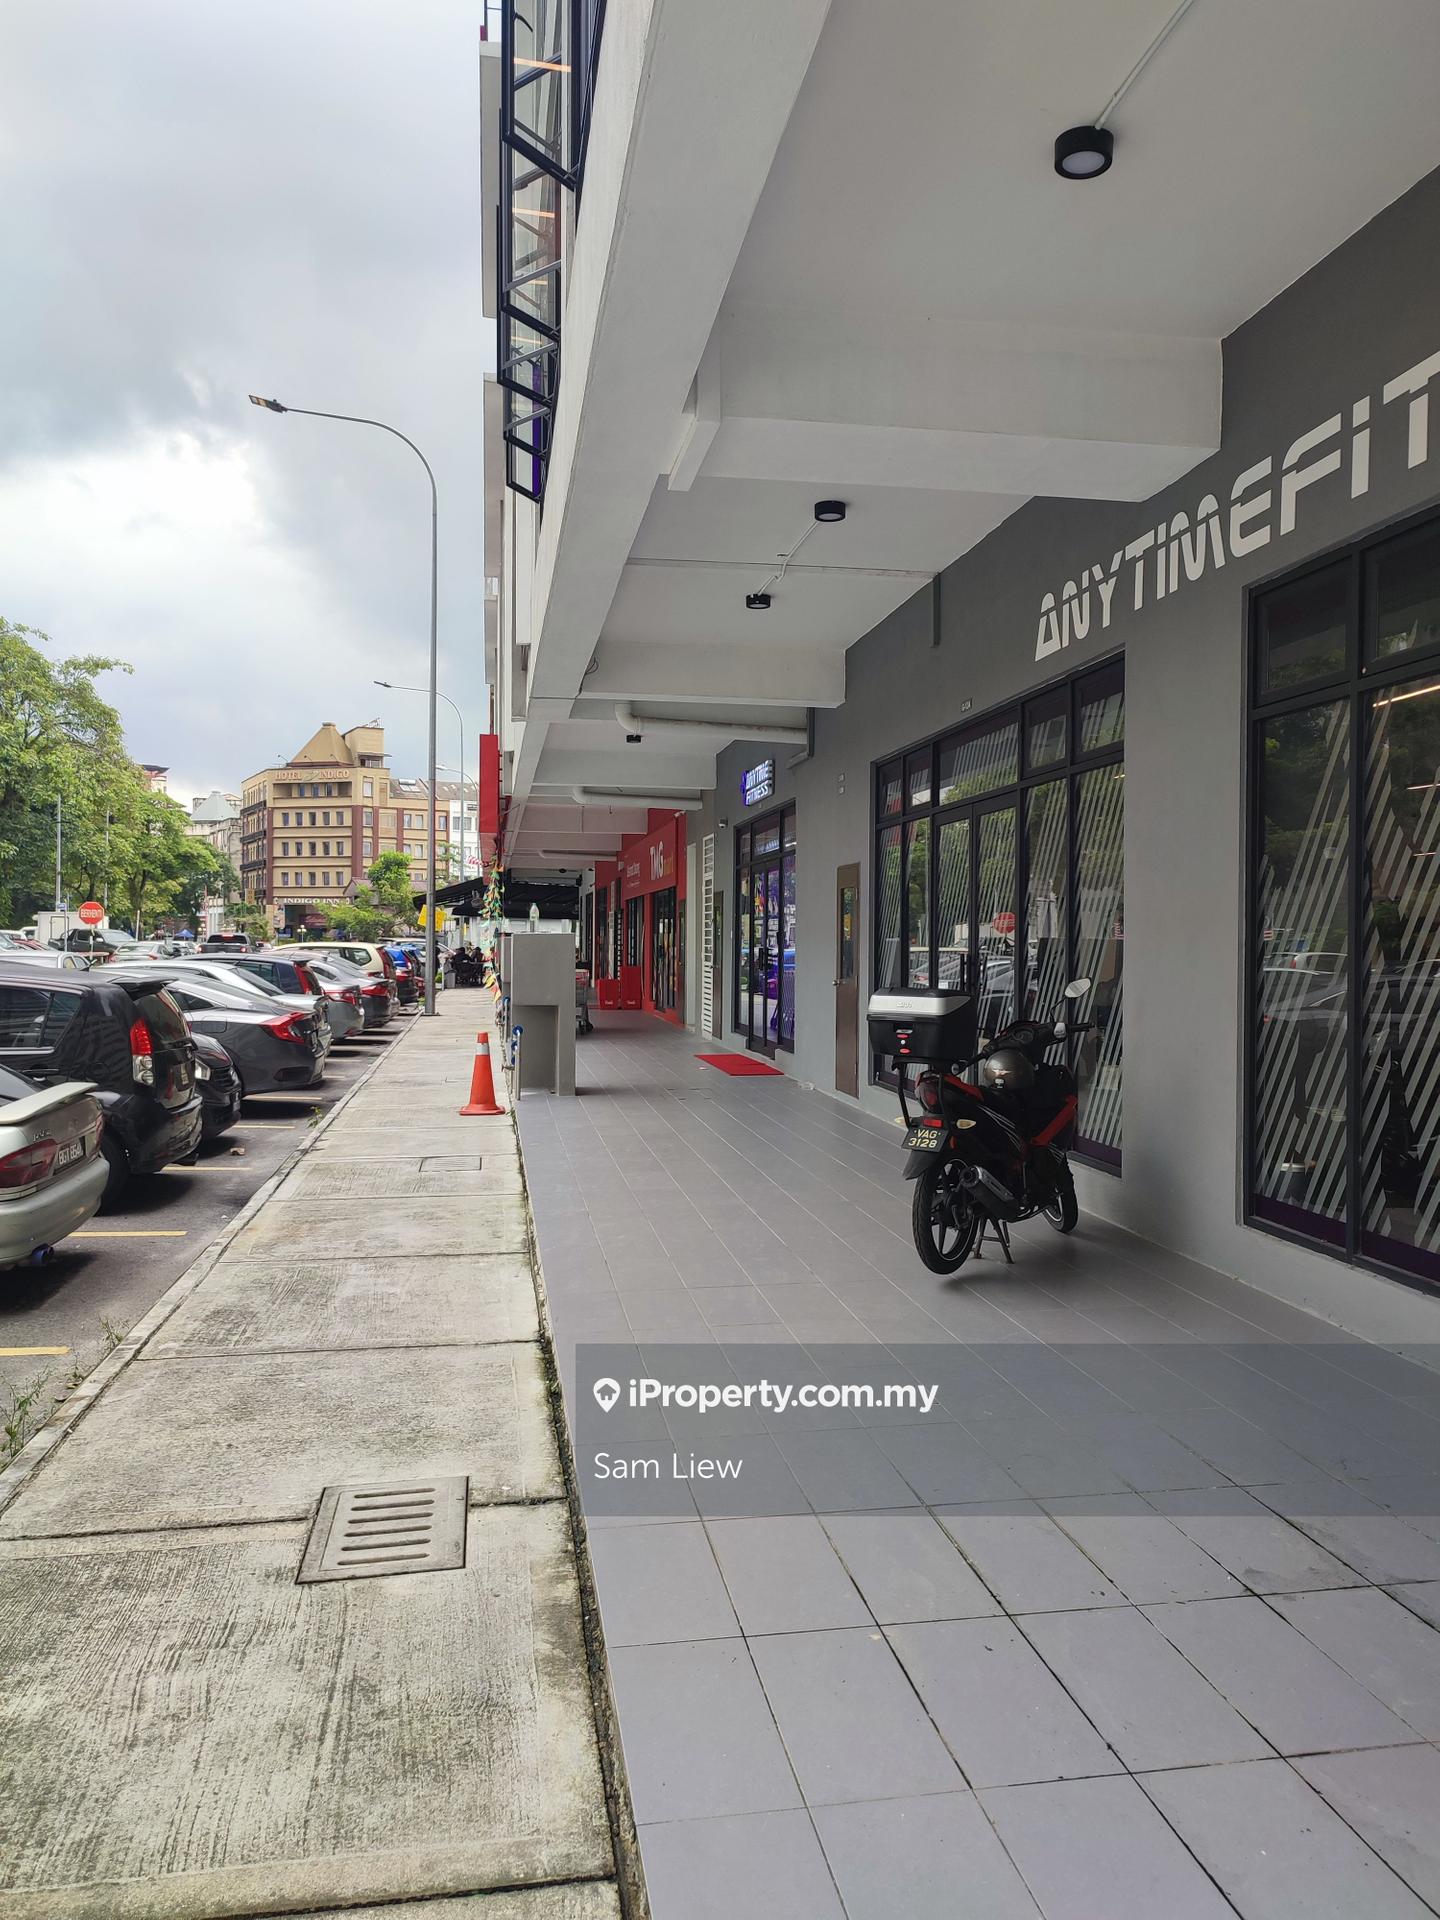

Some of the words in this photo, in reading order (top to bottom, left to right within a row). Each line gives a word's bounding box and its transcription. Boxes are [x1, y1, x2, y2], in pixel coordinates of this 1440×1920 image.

[275, 770, 303, 780] HOTEL
[319, 769, 350, 779] INDIGO
[745, 780, 771, 805] FITNESS
[323, 897, 341, 905] INN
[916, 1128, 938, 1139] VAG
[908, 1137, 938, 1149] 3128
